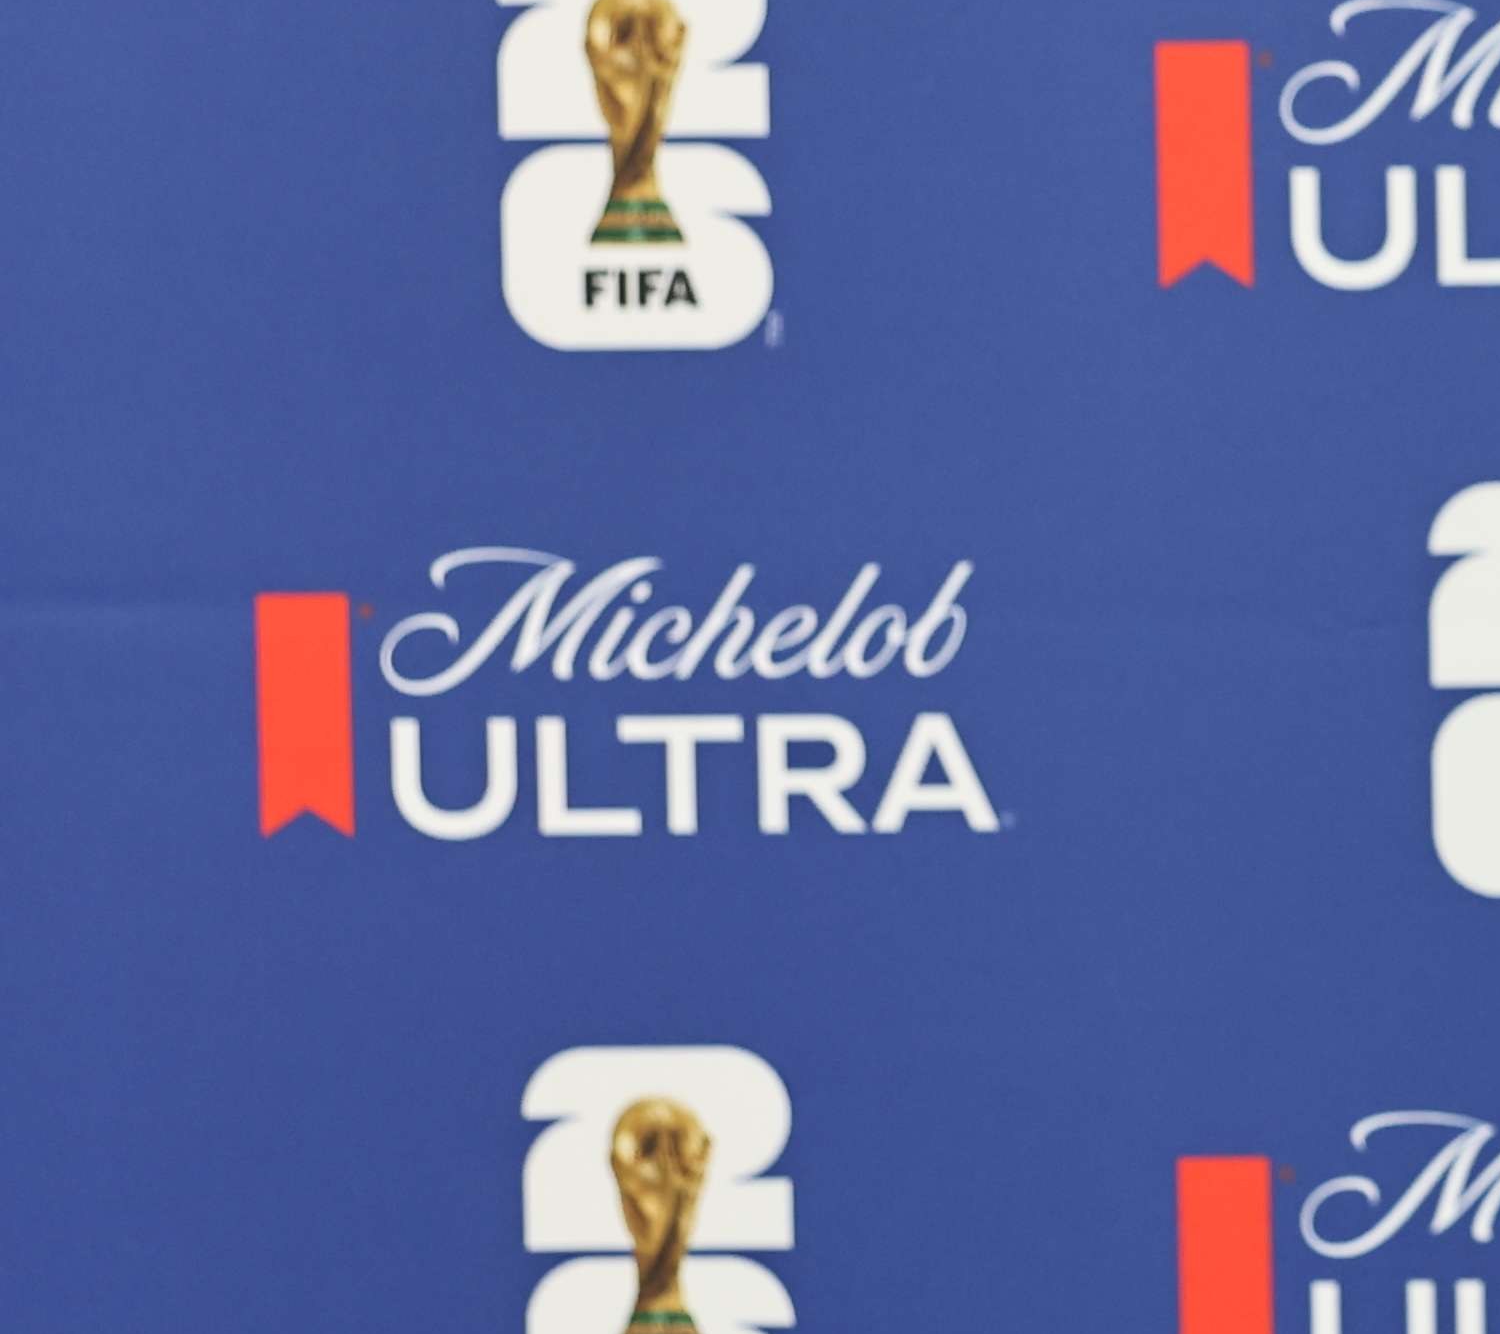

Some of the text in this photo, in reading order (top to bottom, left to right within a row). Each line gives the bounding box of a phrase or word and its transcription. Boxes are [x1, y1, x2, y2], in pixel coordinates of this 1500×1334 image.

[584, 269, 698, 307] FIFA
[381, 548, 971, 695] Michelob
[391, 714, 998, 839] ULTRA
